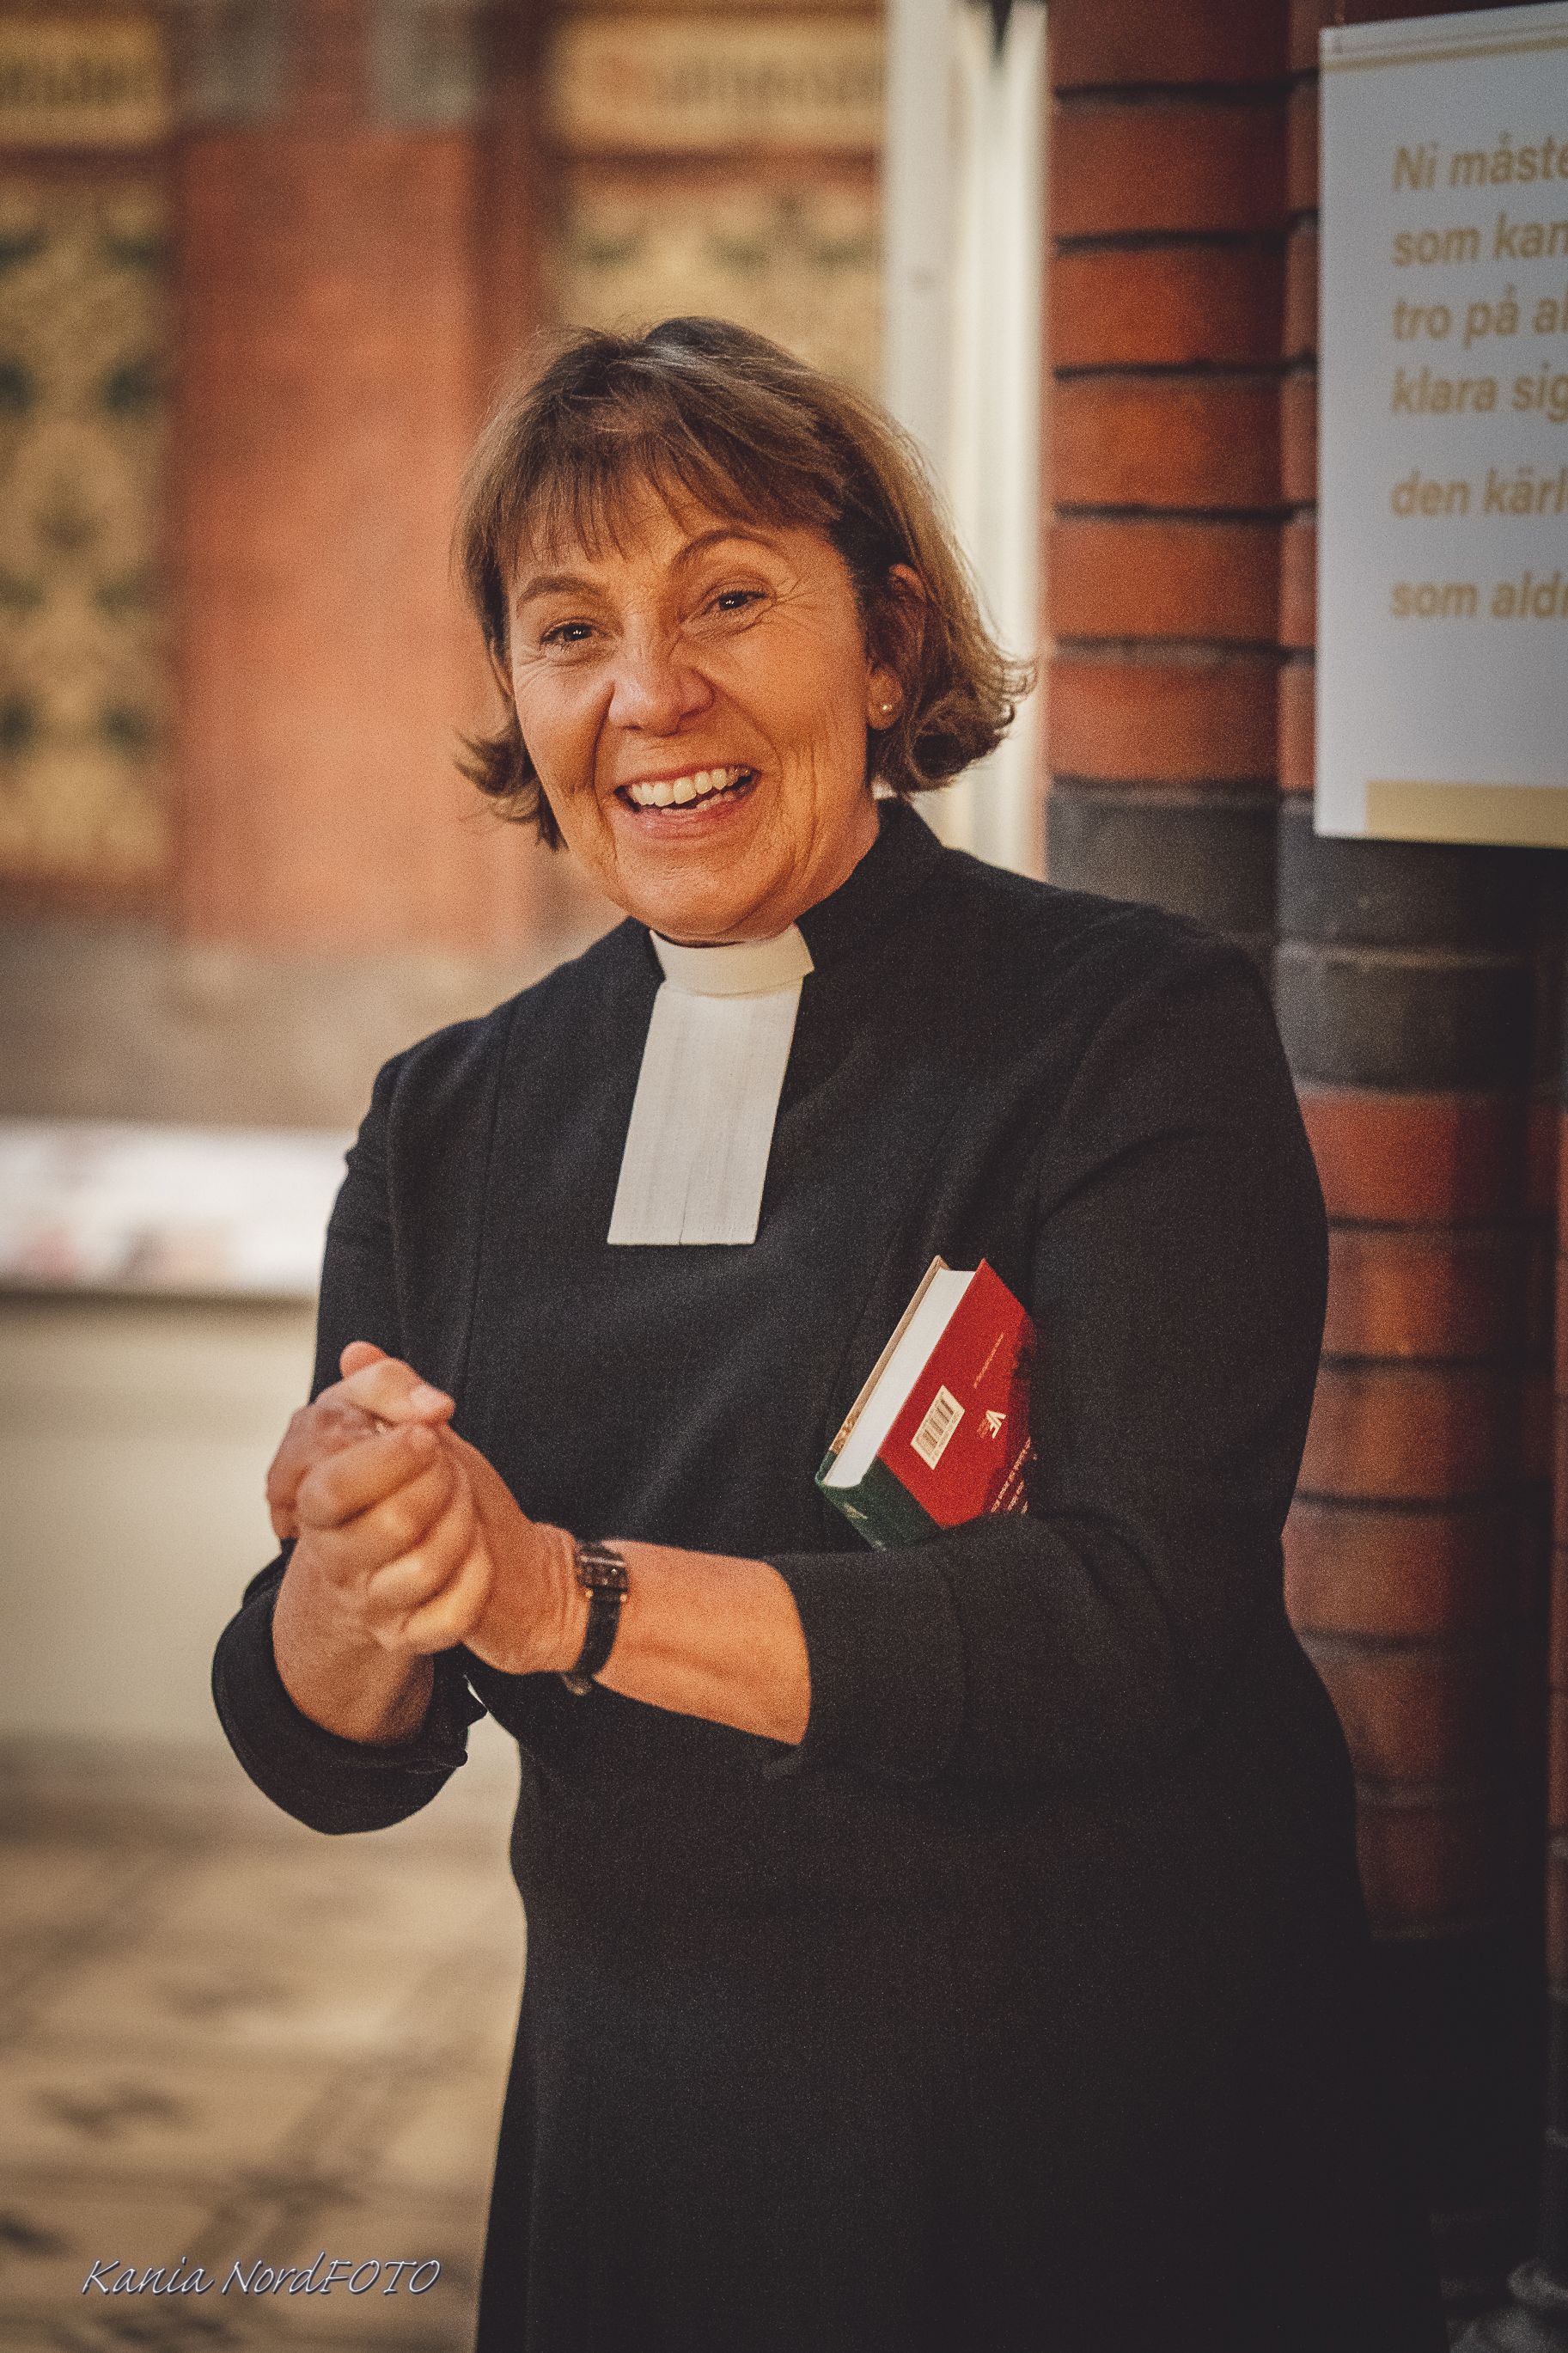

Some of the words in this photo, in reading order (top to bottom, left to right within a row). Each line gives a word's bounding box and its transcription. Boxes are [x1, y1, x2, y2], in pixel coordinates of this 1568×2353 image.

[1393, 142, 1439, 190] Ni
[1392, 228, 1481, 266] som
[1393, 297, 1454, 340] tro
[1461, 284, 1522, 349] på
[1391, 366, 1498, 413] klara
[1511, 362, 1568, 424] sig
[1390, 469, 1472, 516] den
[1391, 584, 1479, 617] som
[1490, 571, 1568, 618] ald
